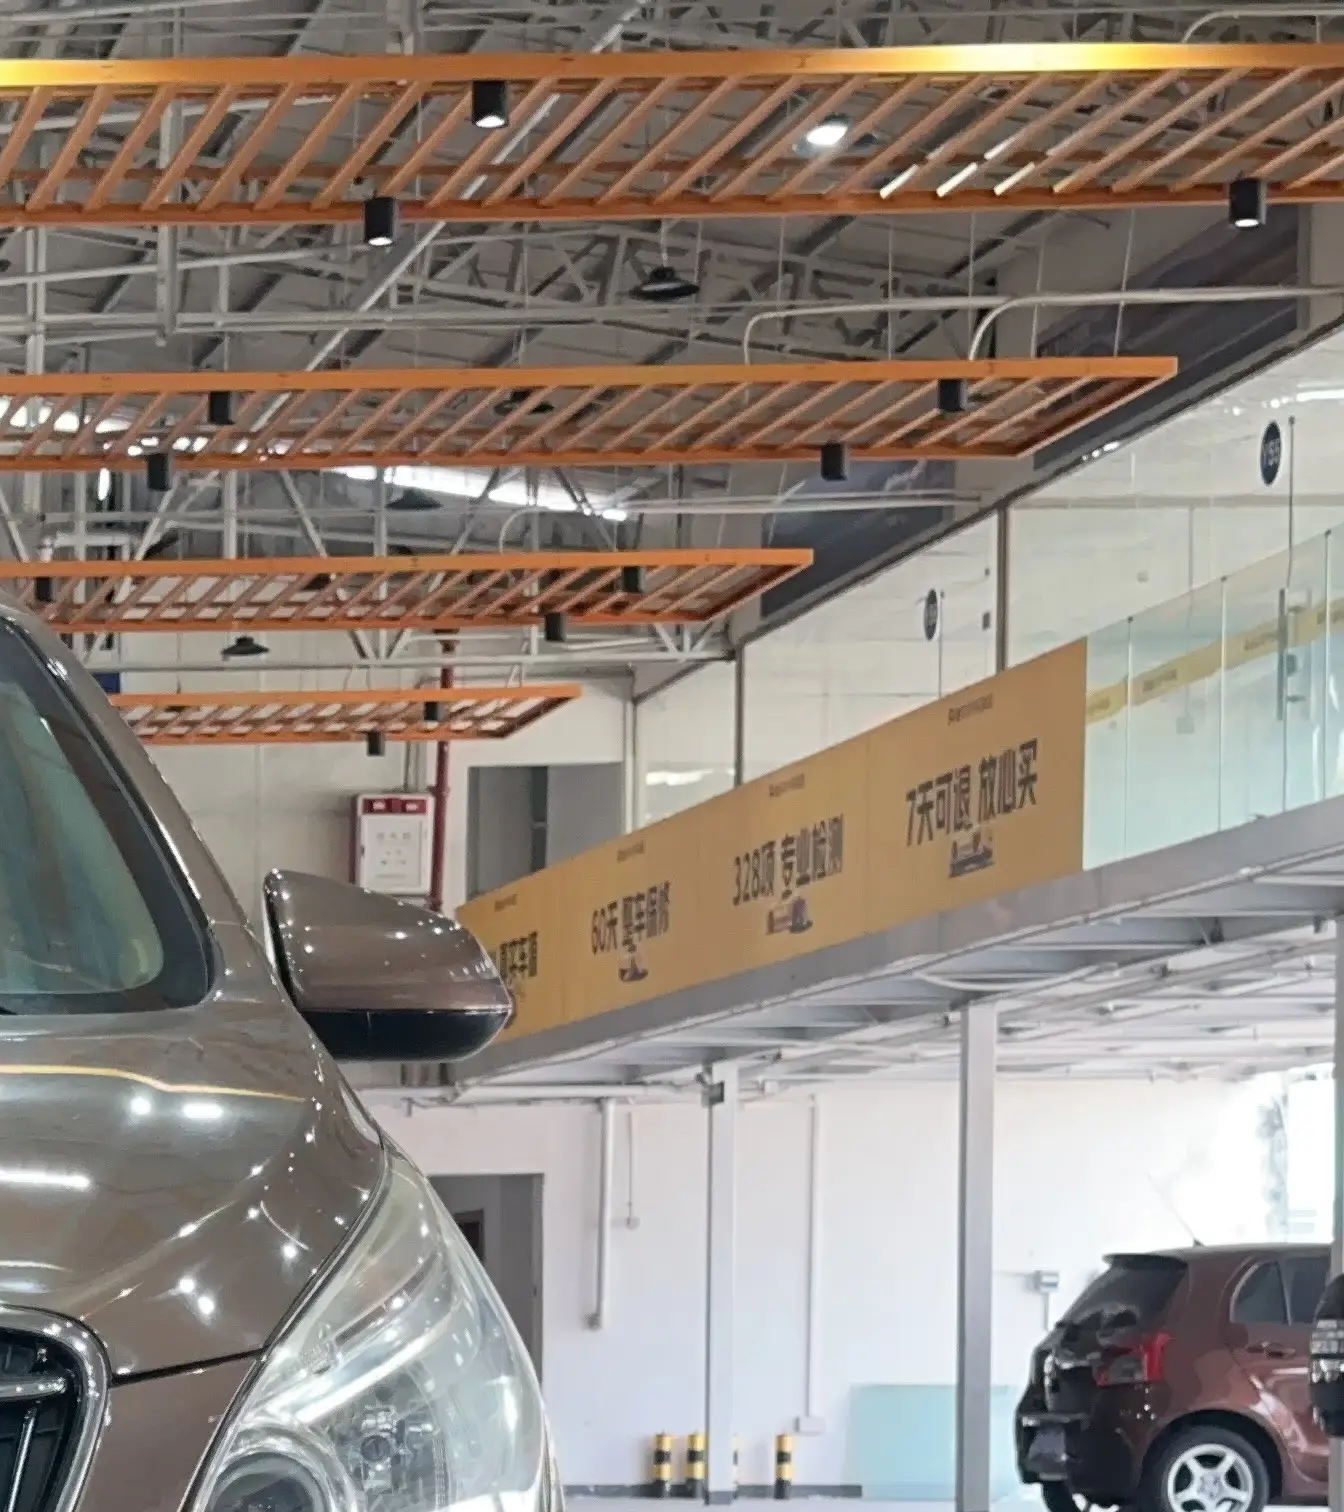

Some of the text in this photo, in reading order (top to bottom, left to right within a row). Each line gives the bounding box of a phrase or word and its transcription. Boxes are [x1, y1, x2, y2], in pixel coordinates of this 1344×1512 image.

[905, 737, 1038, 847] 7天可退 放心买
[733, 813, 844, 906] 328项 专业检测
